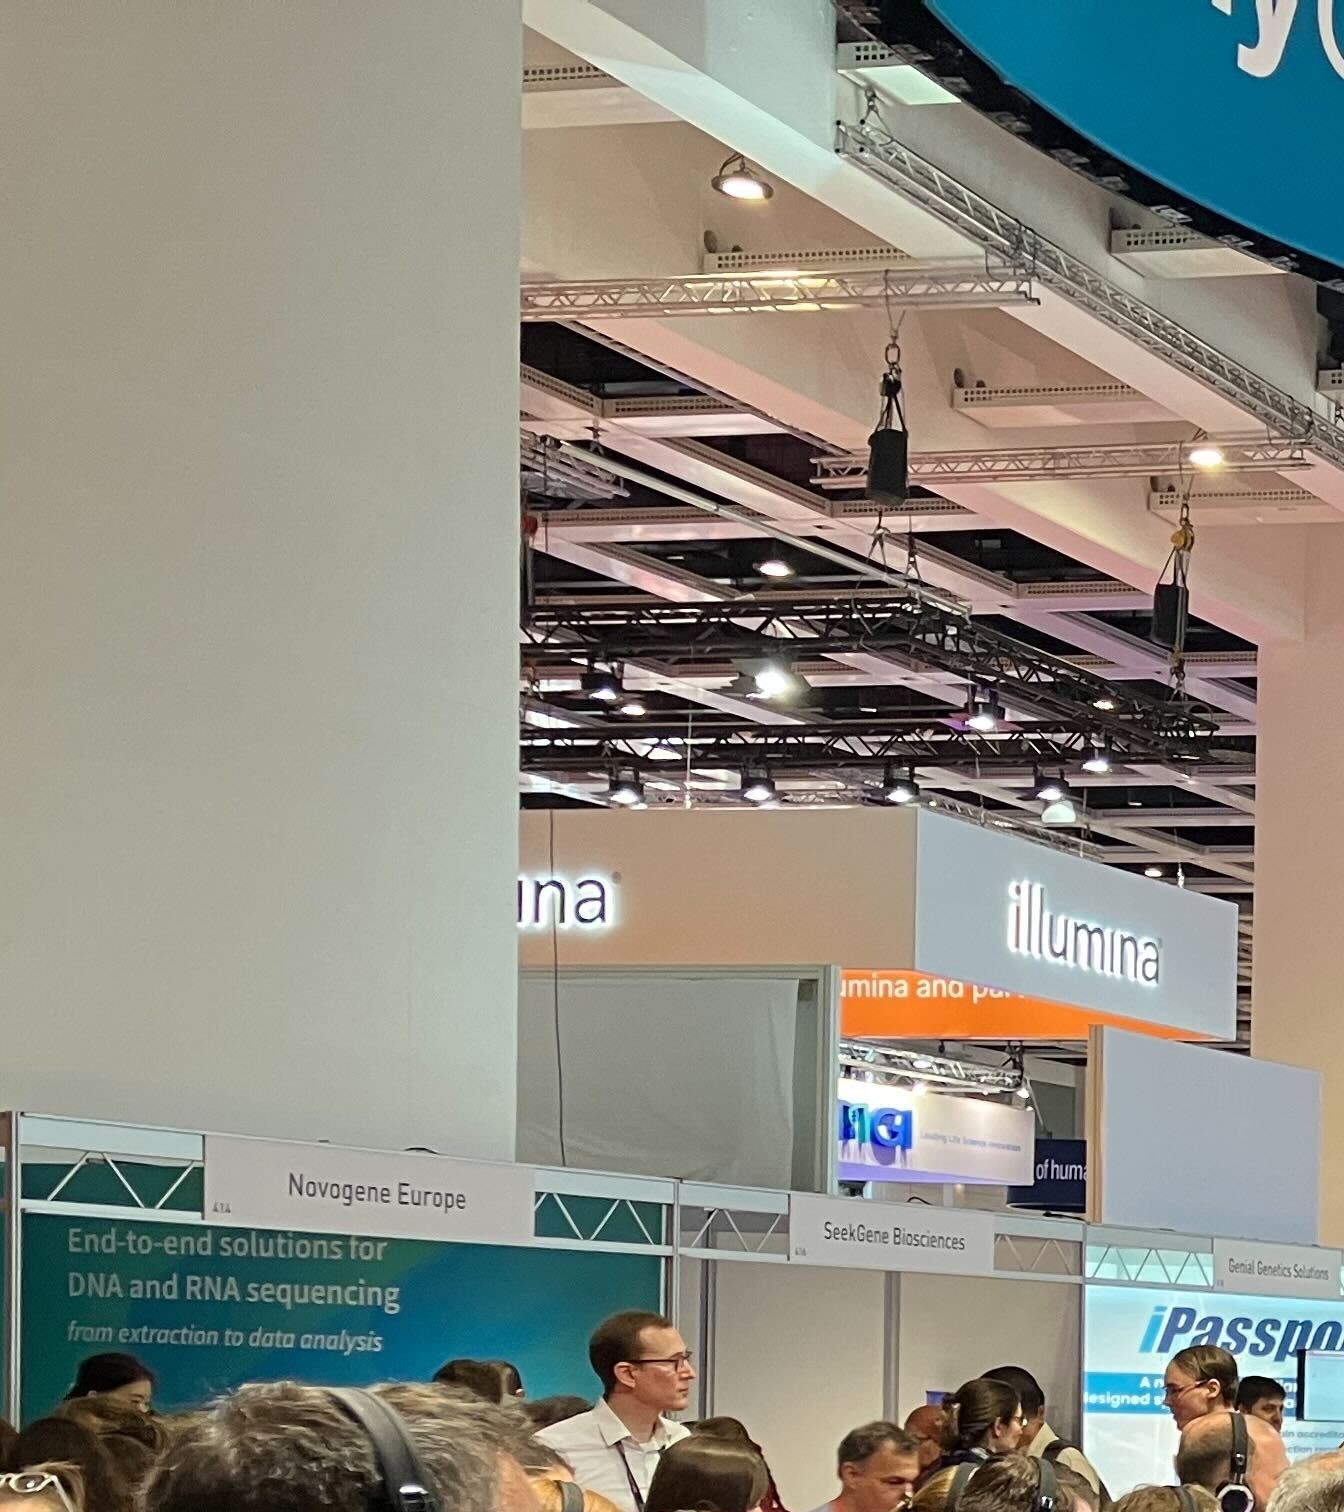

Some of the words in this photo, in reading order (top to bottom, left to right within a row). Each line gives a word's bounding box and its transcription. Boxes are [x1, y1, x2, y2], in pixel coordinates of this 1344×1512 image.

[1010, 882, 1161, 985] illumina
[1036, 1158, 1049, 1180] of
[288, 1172, 391, 1206] Novogene
[397, 1182, 466, 1214] Europe
[67, 1227, 213, 1257] End-to-end
[219, 1231, 343, 1260] solutions
[348, 1235, 388, 1262] for
[823, 1220, 890, 1245] SeekGene
[892, 1227, 966, 1251] Biosciences
[1257, 1260, 1292, 1278] Genetics
[1292, 1263, 1329, 1280] Solutions
[67, 1271, 125, 1299] DNA
[129, 1273, 179, 1300] and
[186, 1274, 240, 1302] RNA
[247, 1278, 401, 1314] sequencing
[67, 1320, 113, 1343] from
[117, 1323, 219, 1347] extraction
[223, 1326, 244, 1347] to
[248, 1326, 296, 1350] data
[300, 1328, 383, 1357] analysis
